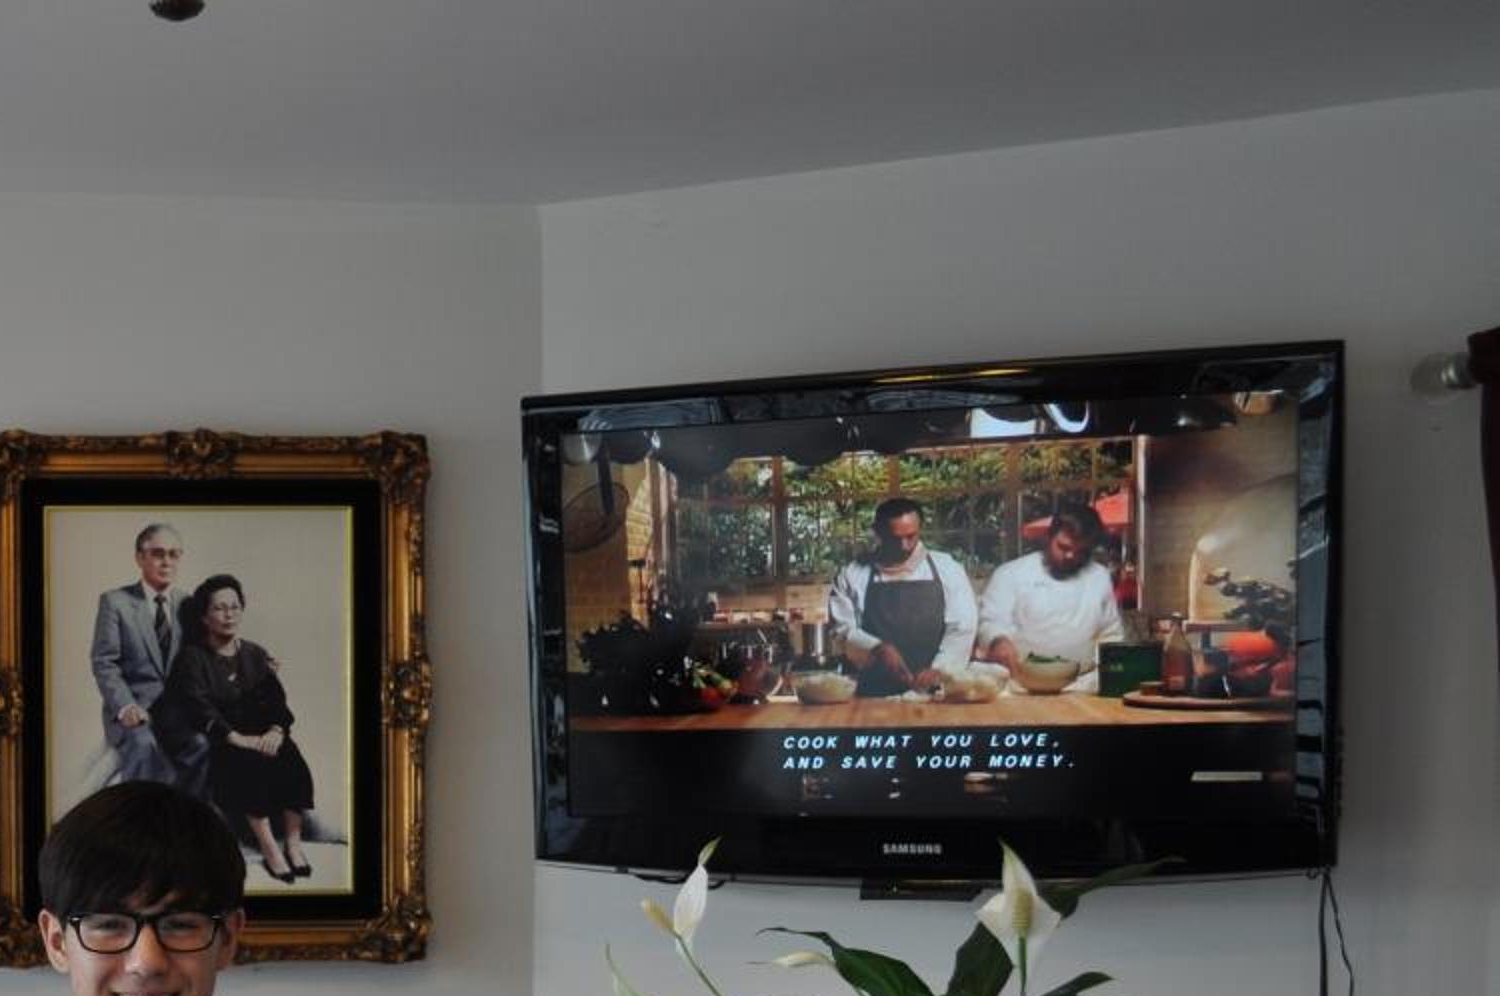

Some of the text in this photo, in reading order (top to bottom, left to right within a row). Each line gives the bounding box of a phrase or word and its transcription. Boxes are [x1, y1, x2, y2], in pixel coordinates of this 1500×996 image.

[783, 736, 838, 749] COOK
[855, 735, 912, 748] WHAT
[931, 734, 972, 748] YOU
[783, 756, 824, 769] AND
[841, 755, 896, 769] SAVE
[916, 755, 971, 768] YOUR
[883, 843, 942, 855] SAMSUNG
